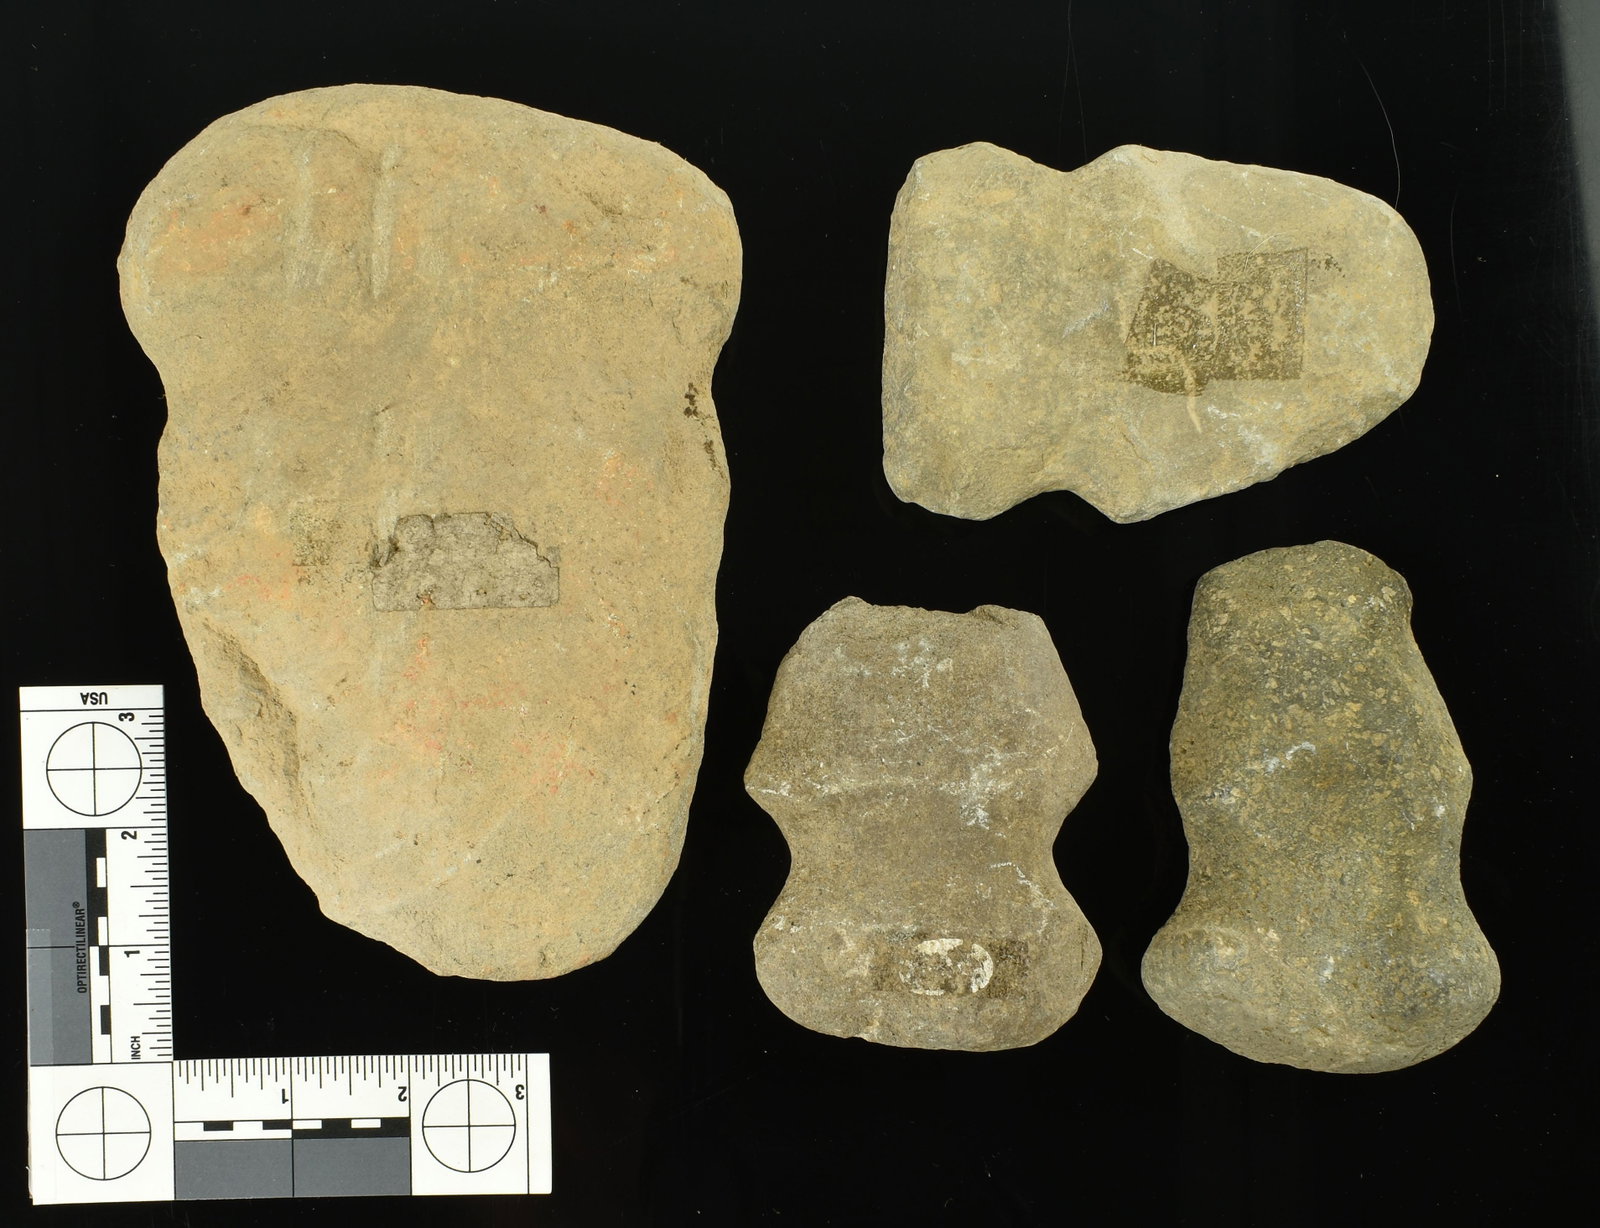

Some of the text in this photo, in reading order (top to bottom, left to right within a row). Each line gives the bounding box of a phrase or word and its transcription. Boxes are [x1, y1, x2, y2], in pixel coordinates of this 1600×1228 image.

[80, 692, 108, 705] USA
[118, 712, 135, 722] 3
[121, 830, 137, 840] 2
[124, 950, 140, 958] 1
[130, 1035, 141, 1060] INCH
[281, 1088, 289, 1104] 1
[397, 1086, 408, 1102] 2
[515, 1084, 525, 1100] 3
